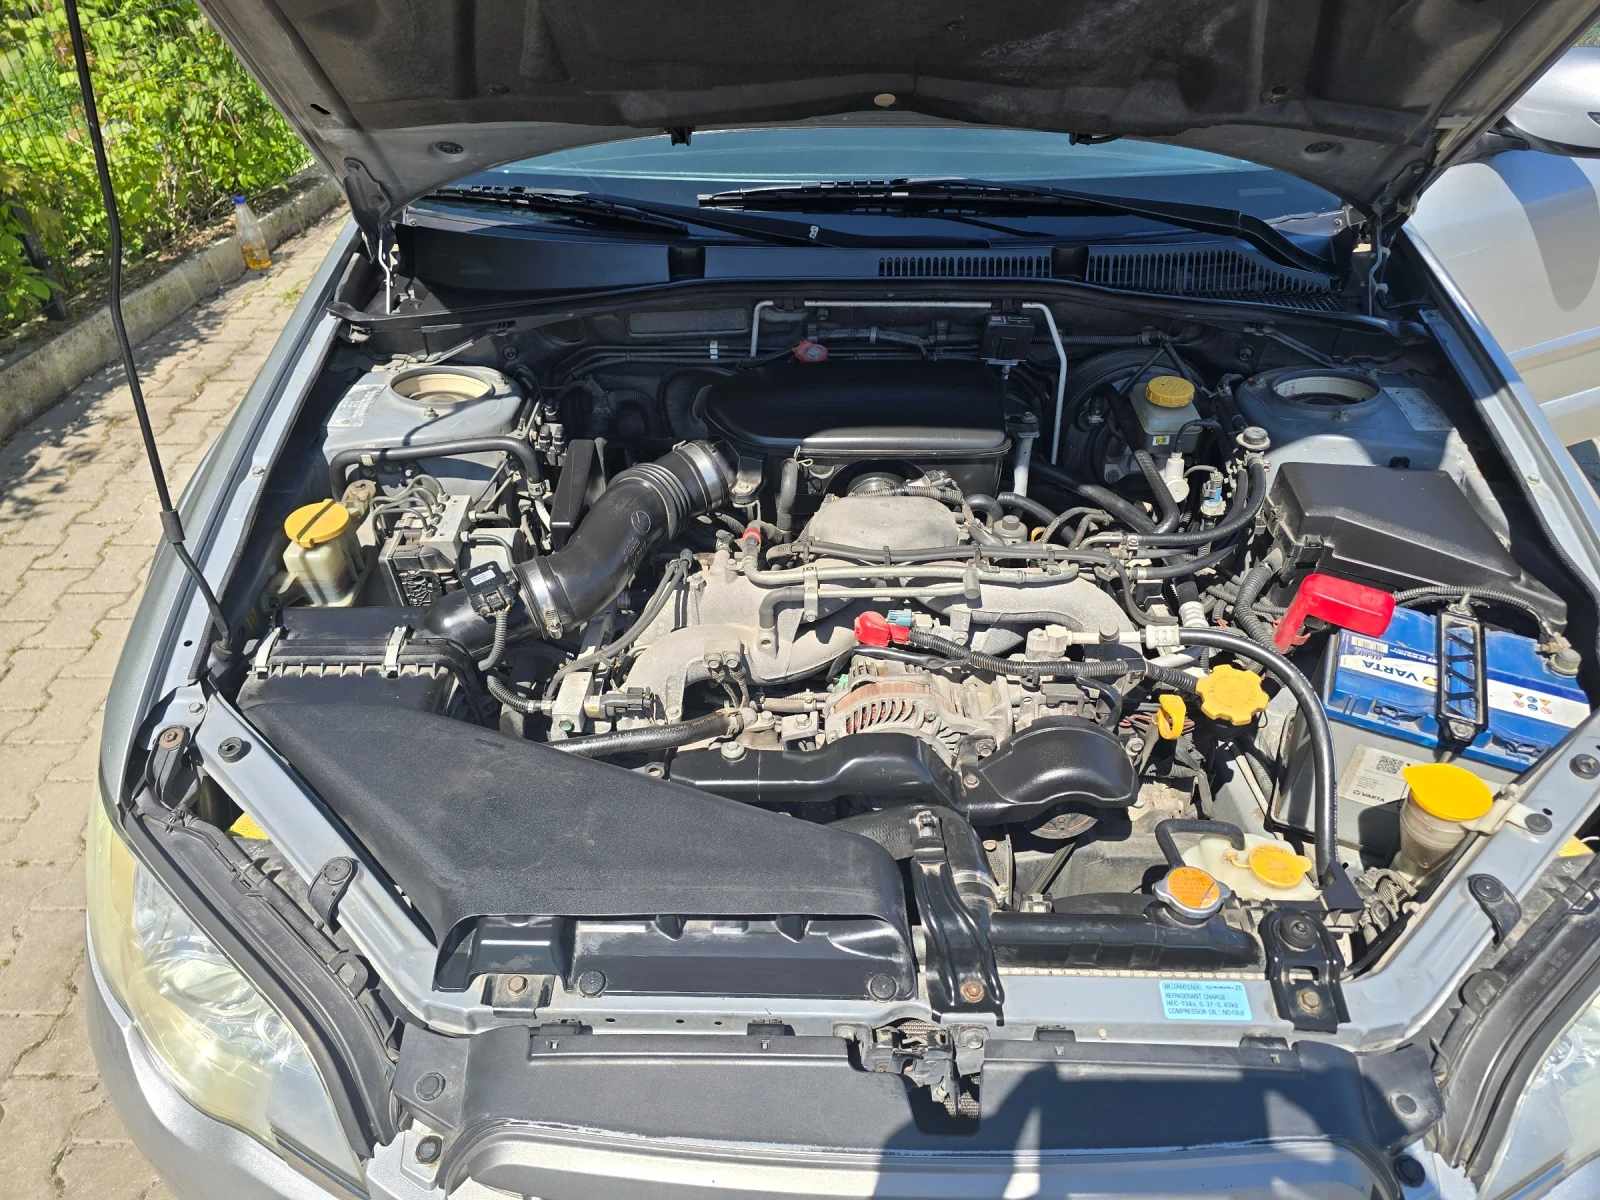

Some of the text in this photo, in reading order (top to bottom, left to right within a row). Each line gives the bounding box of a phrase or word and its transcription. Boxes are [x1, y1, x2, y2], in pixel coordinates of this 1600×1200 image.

[1361, 659, 1418, 682] VARTA
[1361, 792, 1385, 802] VARTA
[1165, 992, 1202, 1000] REFRIGERANT
